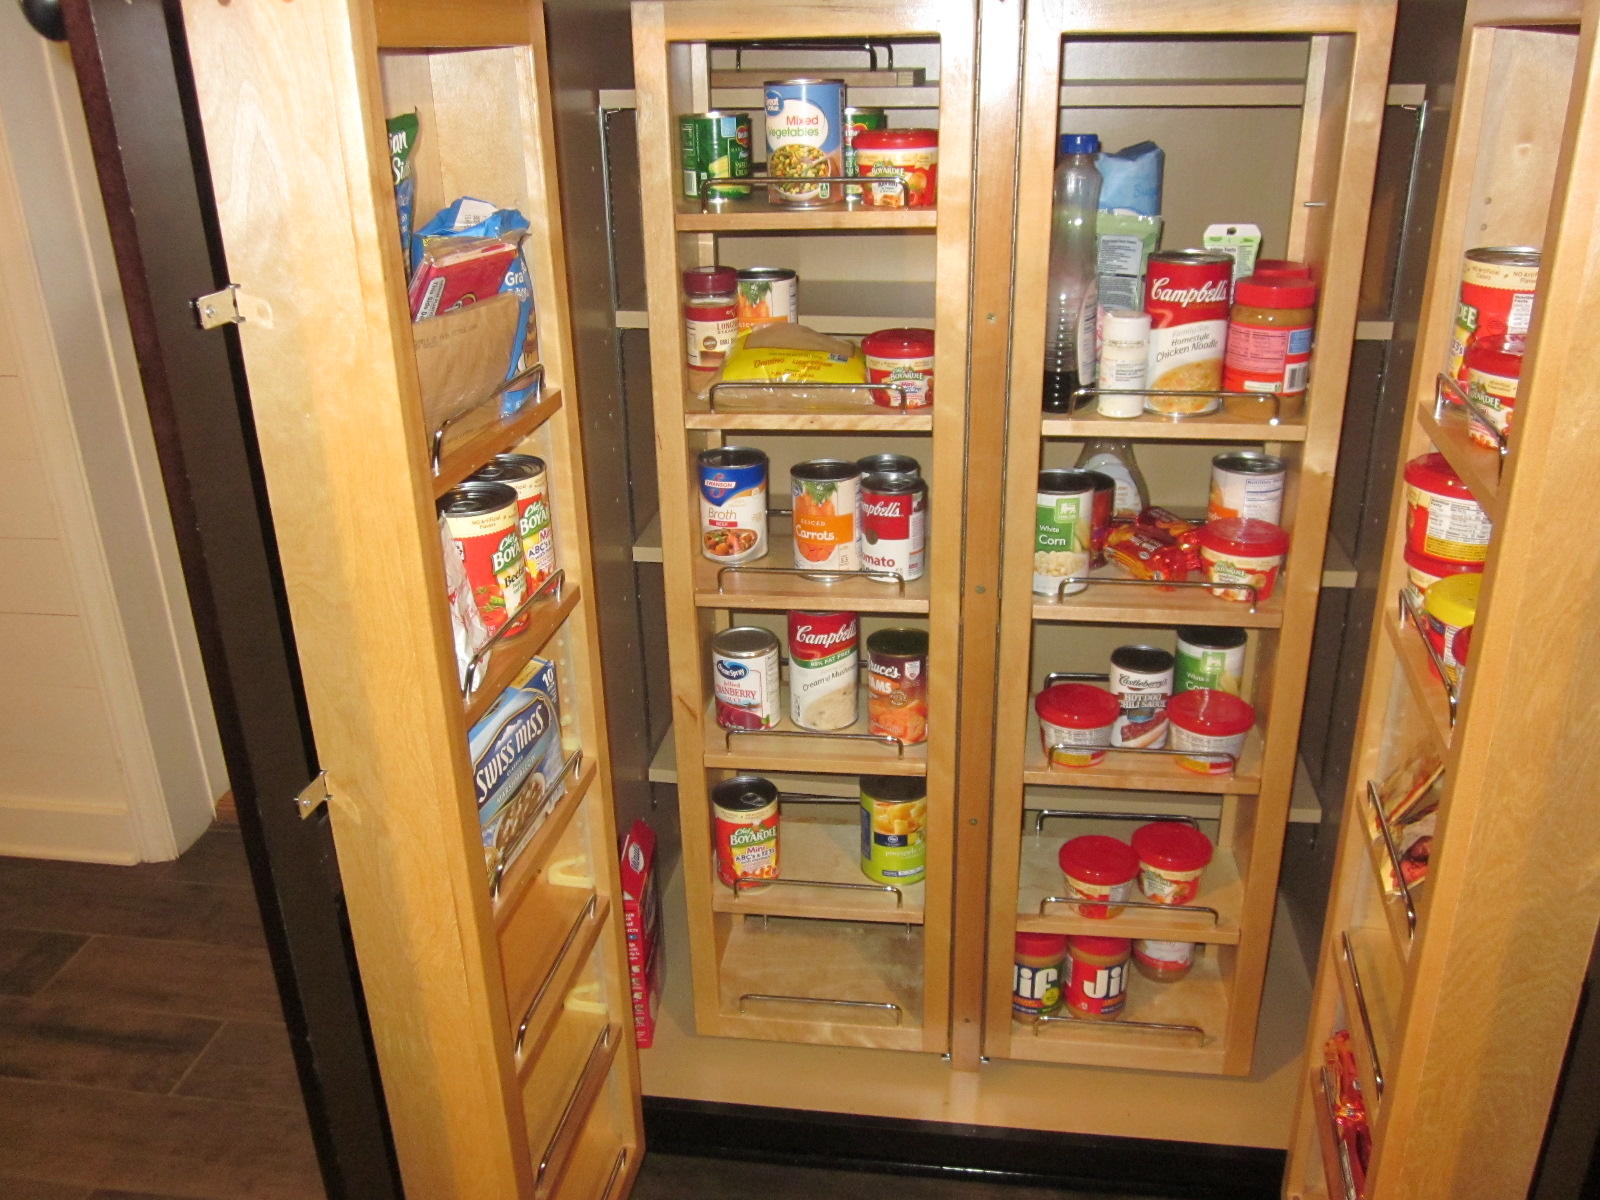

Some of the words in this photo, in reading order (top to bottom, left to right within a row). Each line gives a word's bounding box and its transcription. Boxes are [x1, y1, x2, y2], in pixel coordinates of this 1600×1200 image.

[786, 115, 819, 126] Mixed
[1151, 277, 1228, 308] Campbell's
[1171, 332, 1210, 346] Homestyle
[1156, 345, 1190, 363] Chicken
[708, 507, 737, 520] Broth
[795, 525, 835, 541] Carrots
[1040, 524, 1060, 533] White
[1039, 535, 1066, 546] Corn
[802, 677, 825, 692] Cream
[476, 739, 515, 803] SWISS
[515, 704, 544, 754] MISS
[730, 825, 777, 846] BOYARDEE
